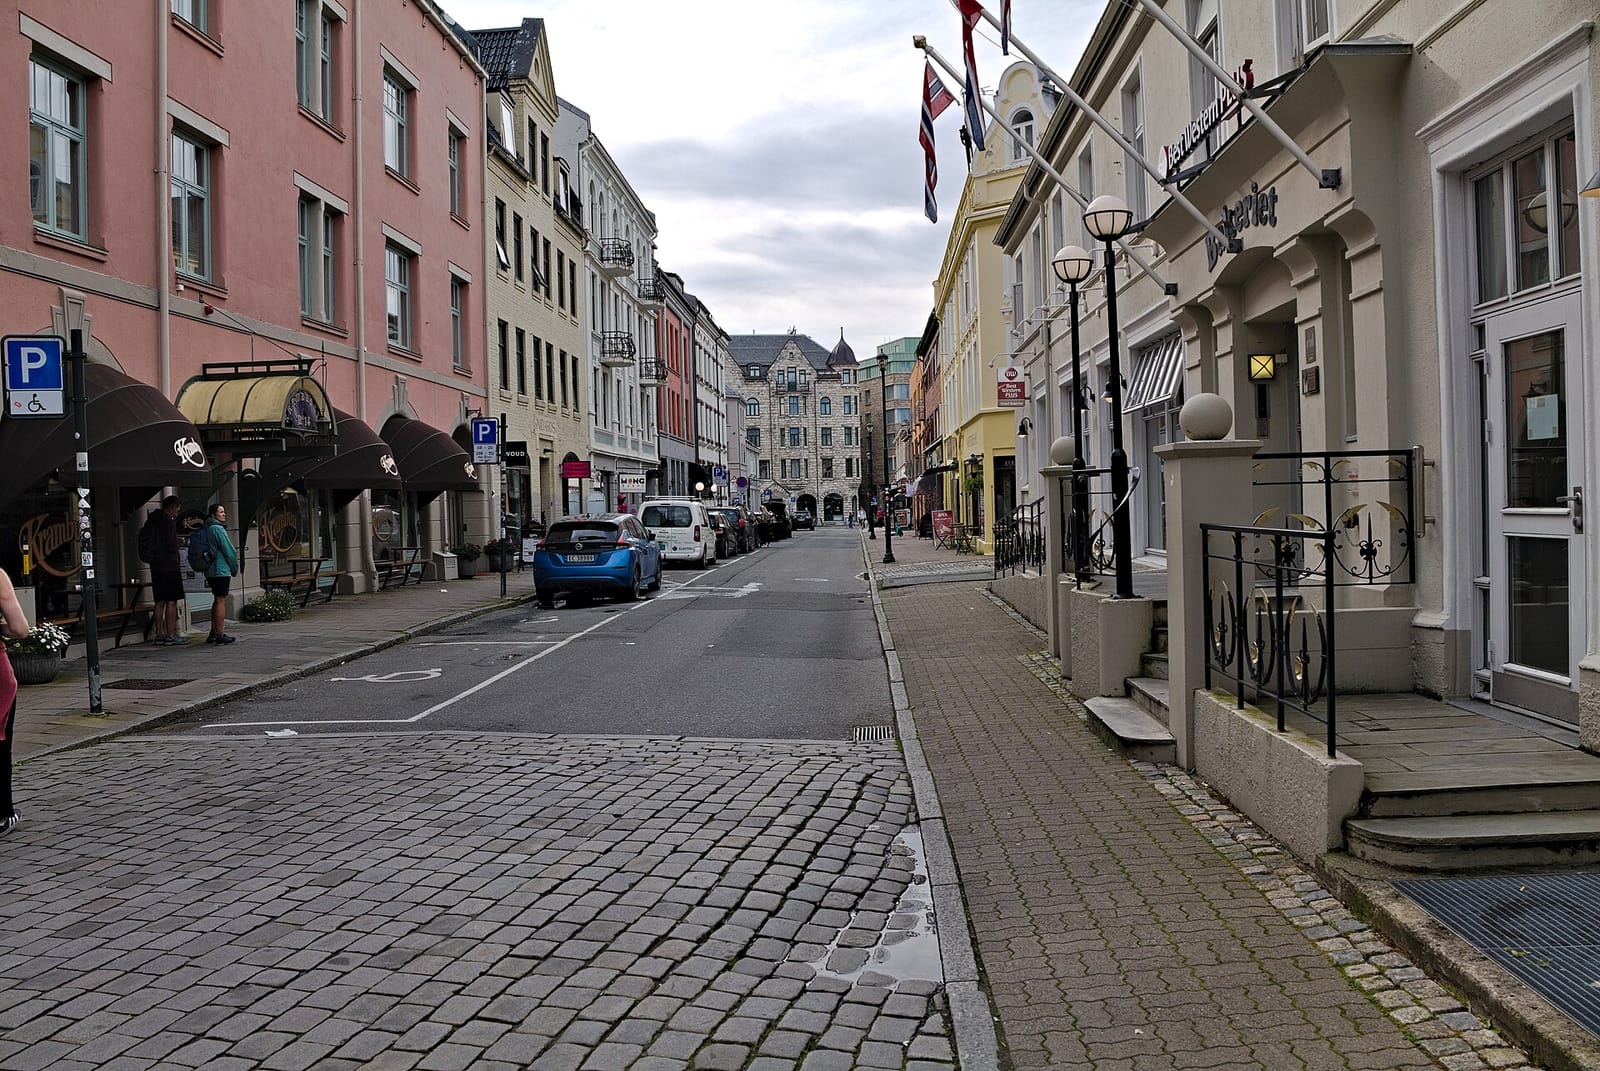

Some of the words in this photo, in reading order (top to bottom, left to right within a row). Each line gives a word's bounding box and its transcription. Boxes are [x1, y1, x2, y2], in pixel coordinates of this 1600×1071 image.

[1168, 138, 1185, 170] Best
[1184, 100, 1220, 152] Western
[20, 346, 47, 384] P
[478, 423, 491, 441] P
